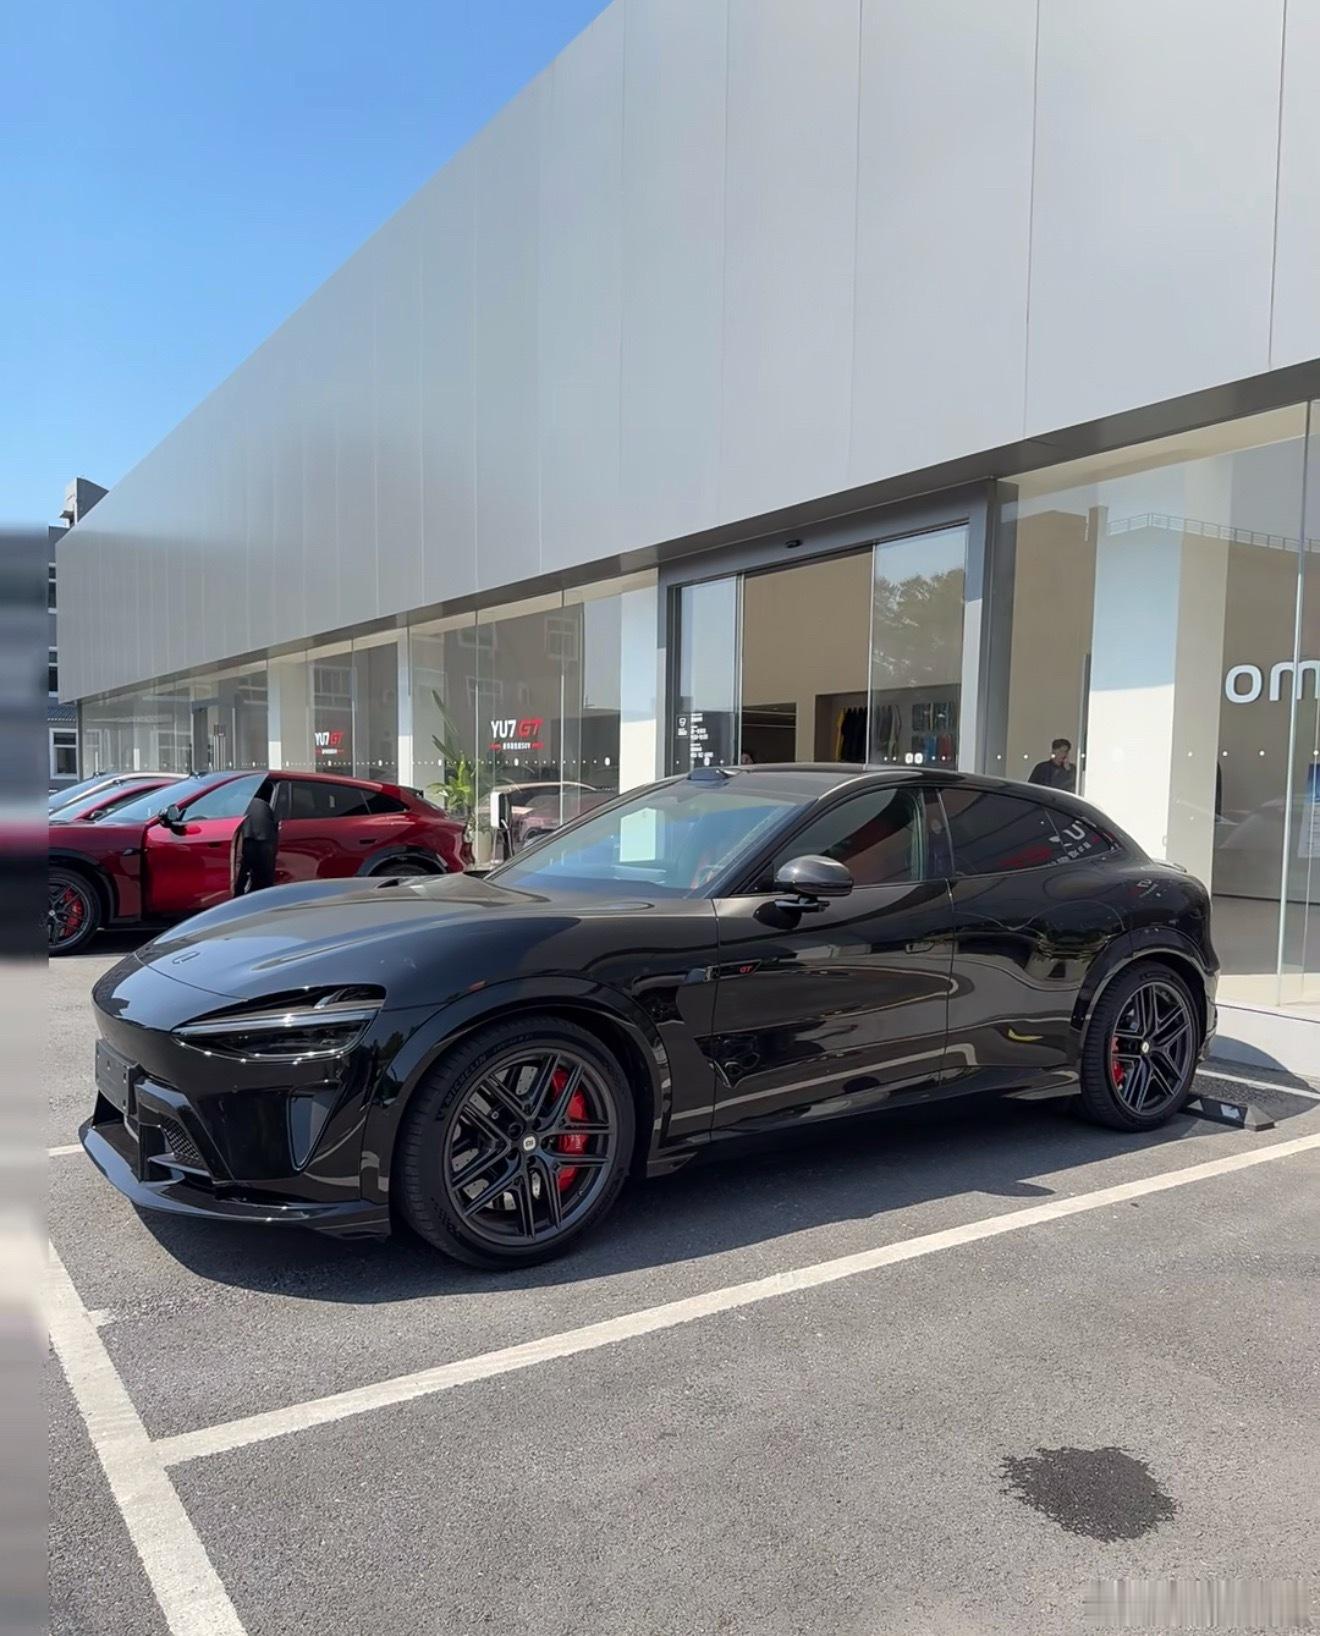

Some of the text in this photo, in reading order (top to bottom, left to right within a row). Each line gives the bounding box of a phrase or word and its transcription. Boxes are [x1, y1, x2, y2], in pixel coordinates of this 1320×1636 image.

[490, 718, 544, 738] YU7 GT
[314, 731, 330, 746] YU7
